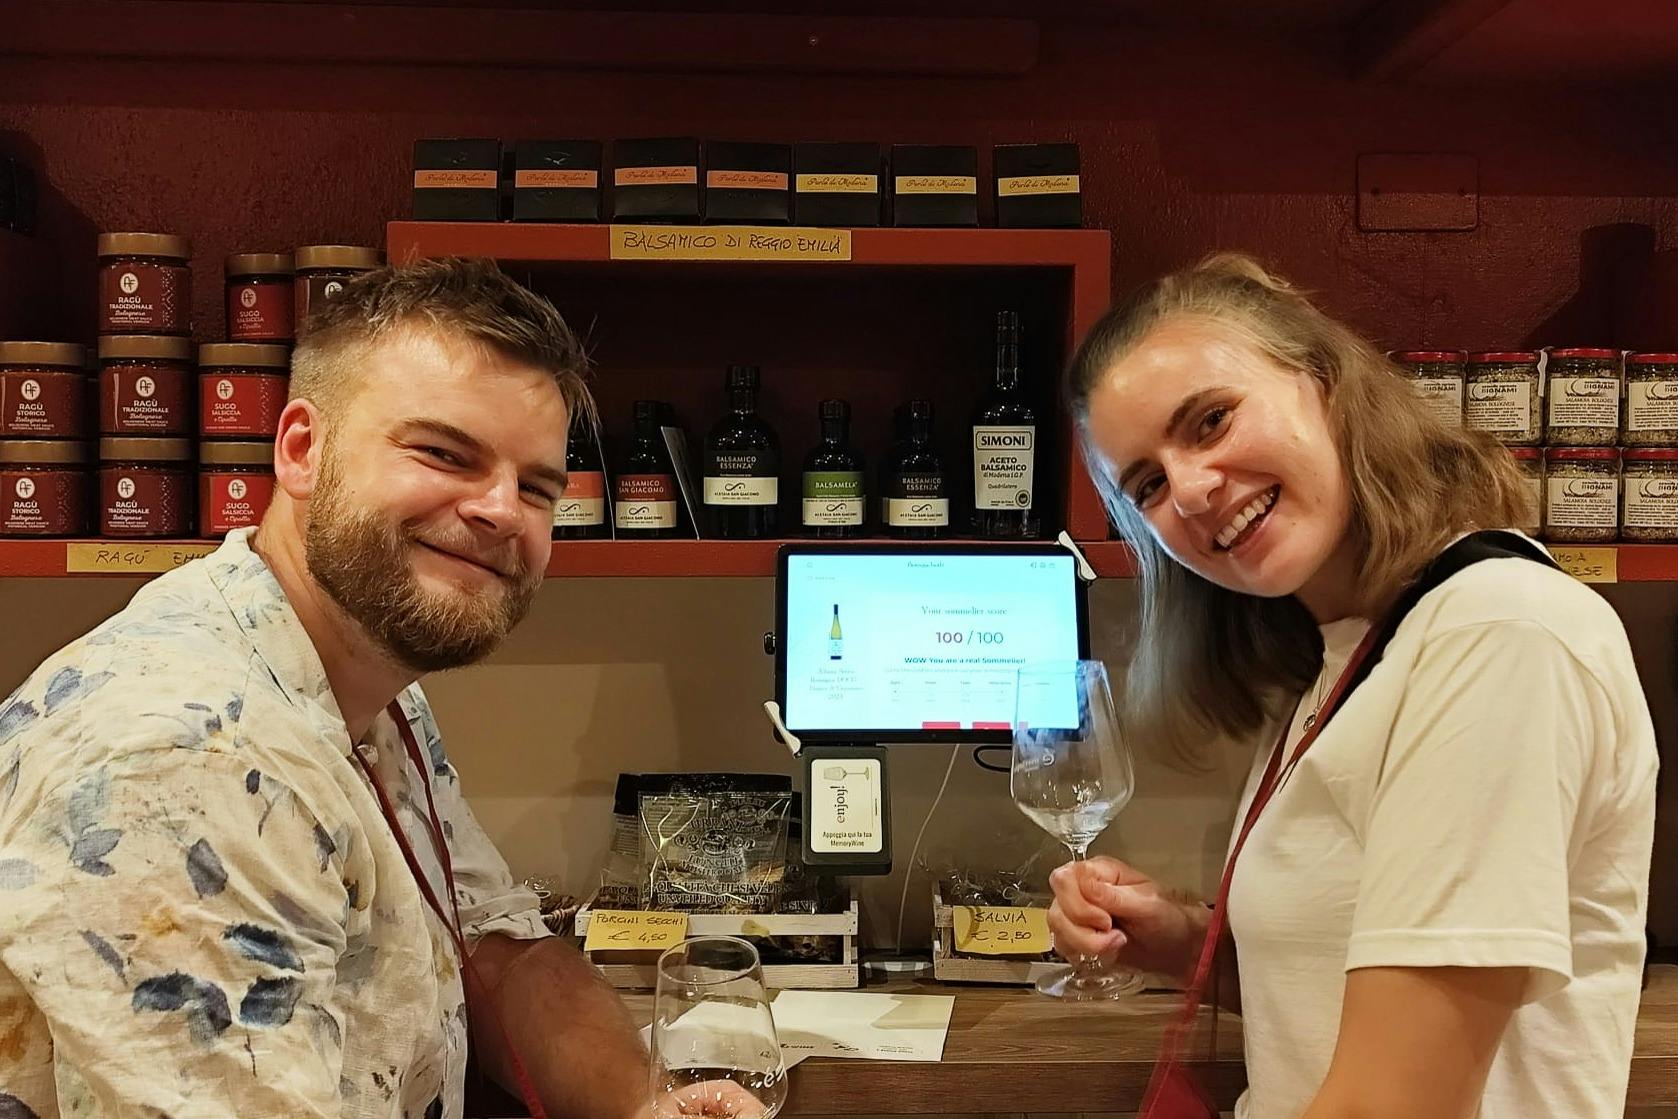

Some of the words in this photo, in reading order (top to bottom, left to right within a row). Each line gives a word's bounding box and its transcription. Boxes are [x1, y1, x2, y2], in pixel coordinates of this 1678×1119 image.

[623, 231, 717, 253] BALSAMICO
[725, 234, 741, 248] DI
[749, 233, 792, 250] REGGIO
[797, 234, 842, 254] EMILIA
[980, 435, 1026, 446] SIMONI
[618, 486, 629, 494] SAN
[630, 486, 664, 494] GIACOMO
[226, 502, 250, 510] SUGO
[921, 605, 942, 616] Your
[987, 608, 1008, 616] score
[936, 632, 964, 644] 100
[977, 632, 1004, 644] 100
[830, 785, 848, 824] enjoy!
[822, 831, 847, 840] Appoggia
[848, 831, 856, 840] qui
[596, 913, 639, 924] PORCINI
[646, 916, 684, 926] SECCHI
[974, 910, 1027, 924] SALVIA
[608, 930, 630, 941] €
[638, 932, 668, 944] 4,50
[971, 930, 990, 942] €
[996, 930, 1032, 944] 2,50
